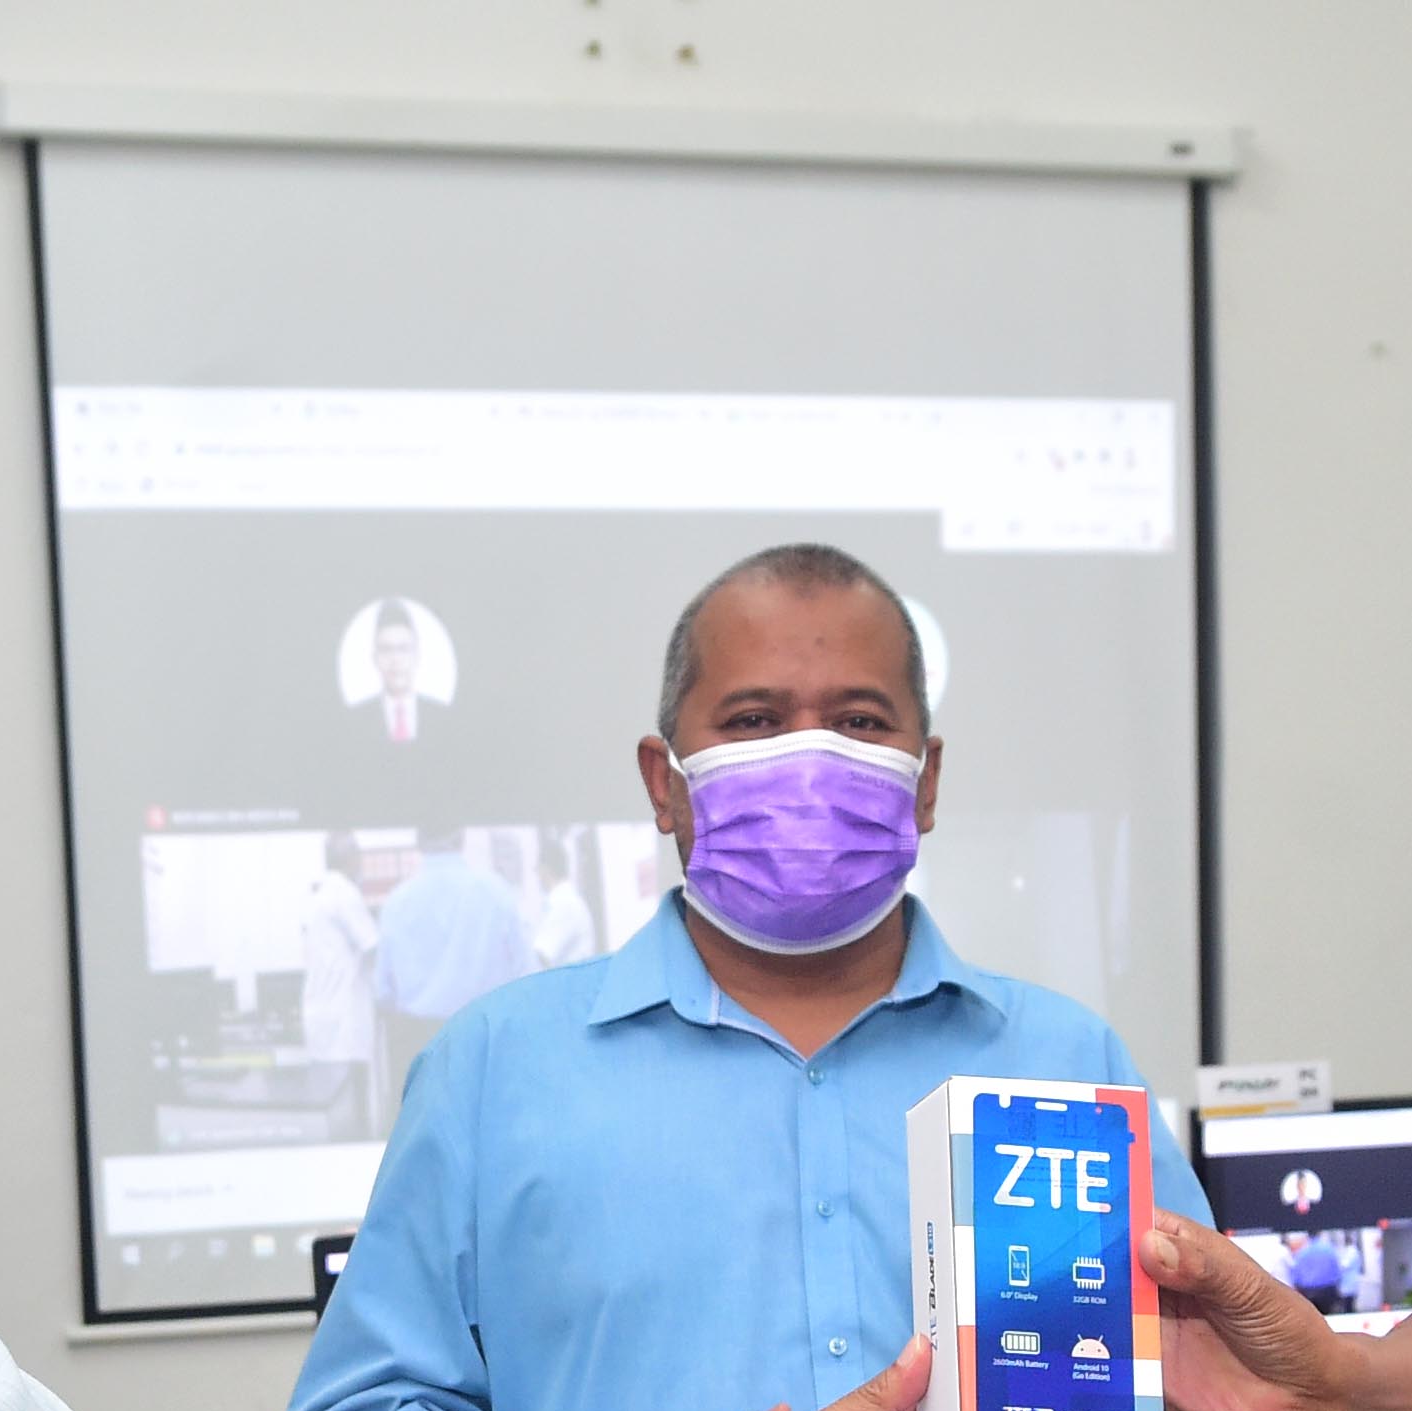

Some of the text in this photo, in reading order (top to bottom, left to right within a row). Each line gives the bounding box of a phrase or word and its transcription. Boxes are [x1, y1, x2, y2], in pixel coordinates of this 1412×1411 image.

[994, 1144, 1112, 1213] ZTE
[1014, 1292, 1038, 1302] Display
[929, 1316, 938, 1351] ZTE
[1025, 1360, 1050, 1370] Battery
[1073, 1363, 1100, 1372] Android
